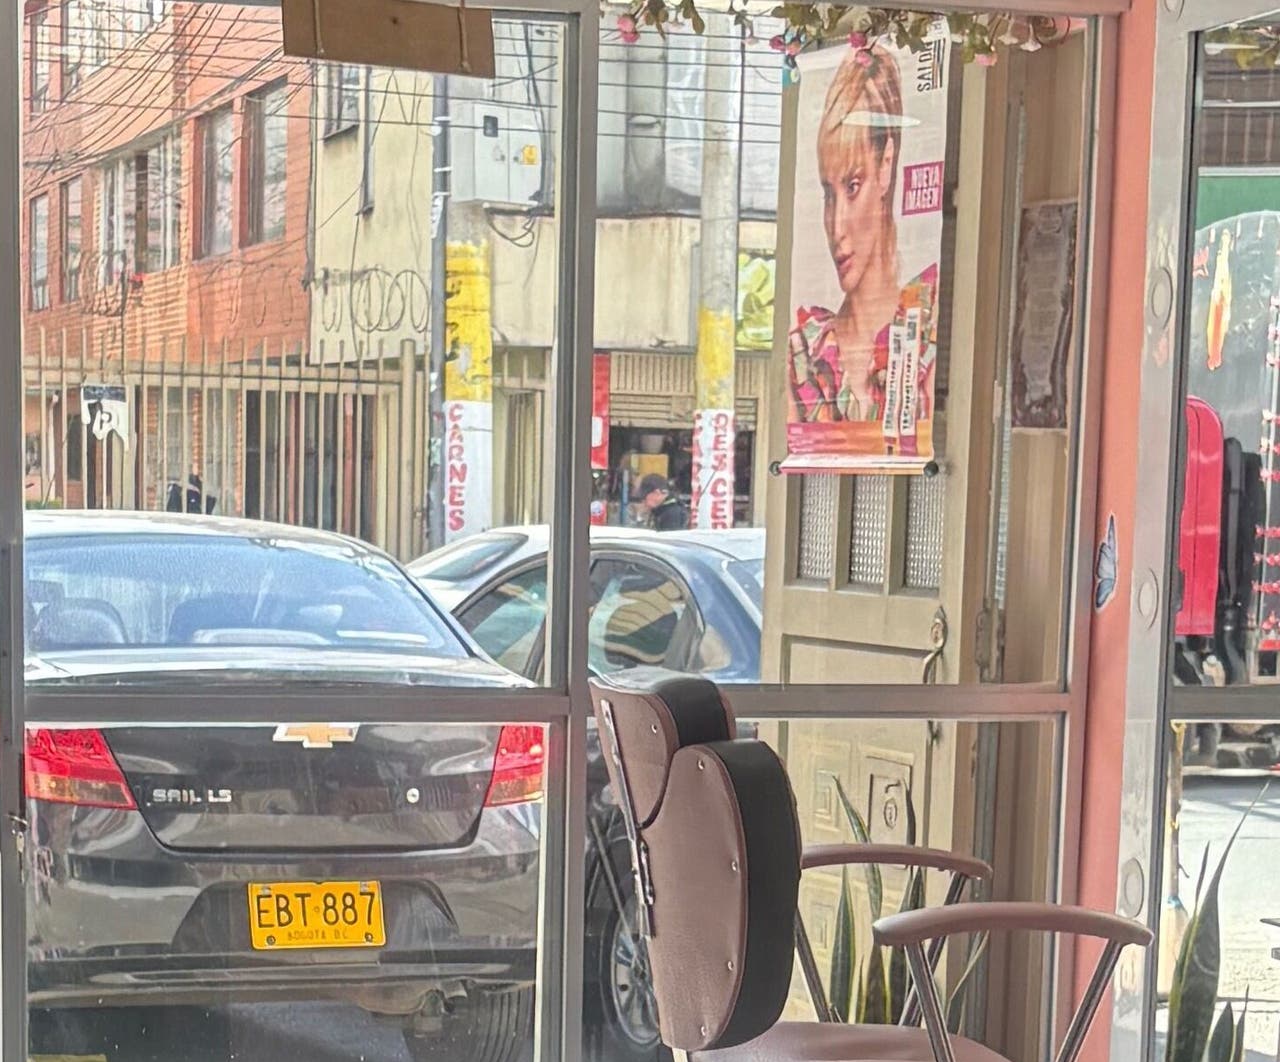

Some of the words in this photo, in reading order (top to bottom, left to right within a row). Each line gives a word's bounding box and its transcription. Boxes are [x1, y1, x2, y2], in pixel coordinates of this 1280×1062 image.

[911, 166, 939, 188] NUEVA
[905, 188, 939, 210] IMAGEN
[449, 404, 467, 531] CARNES
[153, 788, 202, 804] SAIL
[208, 789, 232, 803] LS
[256, 894, 312, 928] EBT
[323, 892, 375, 925] 887
